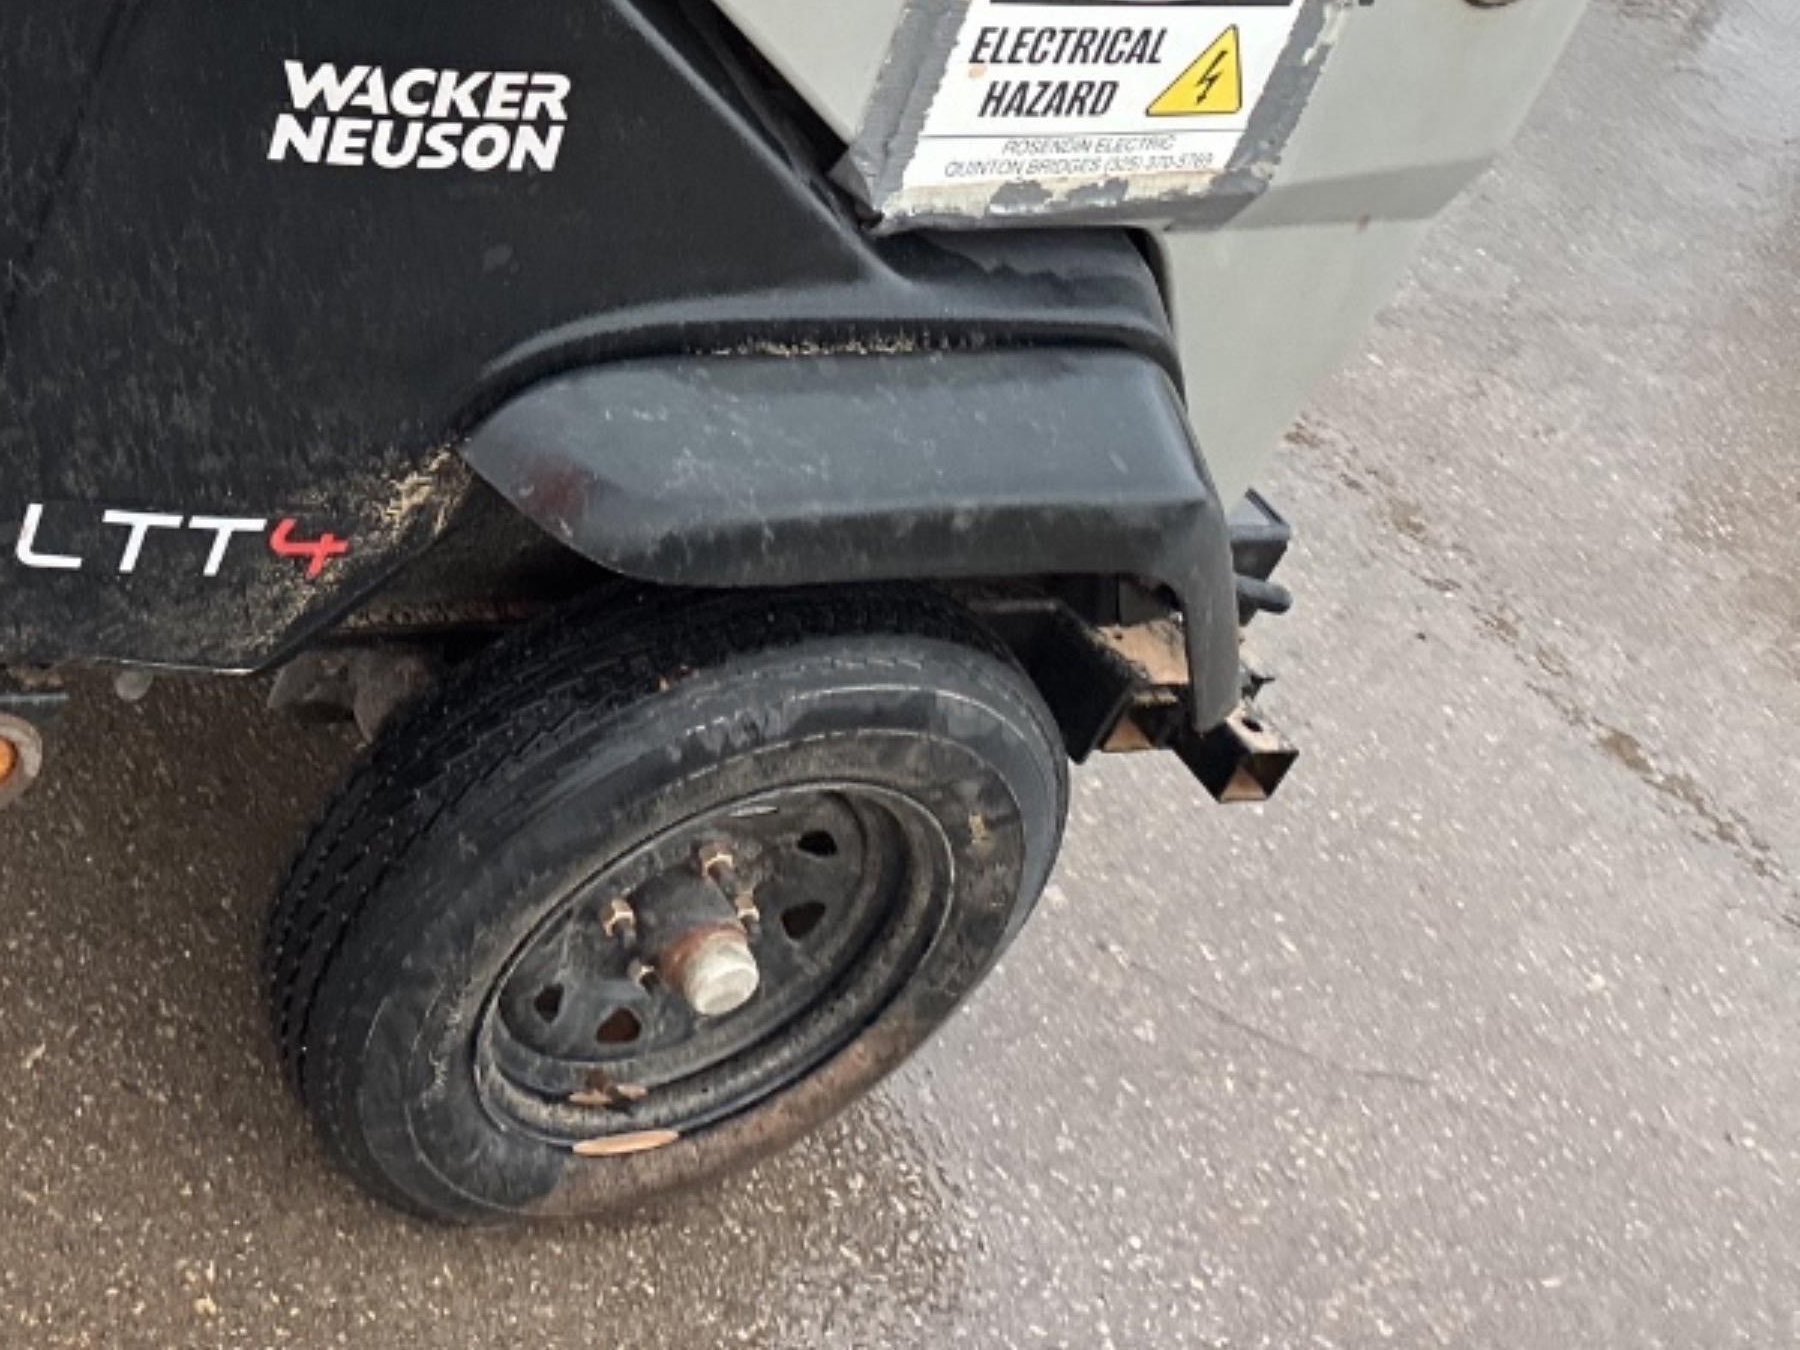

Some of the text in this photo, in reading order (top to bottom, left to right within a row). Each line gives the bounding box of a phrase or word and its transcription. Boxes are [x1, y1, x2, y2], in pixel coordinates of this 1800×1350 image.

[968, 26, 1170, 66] ELECTRICAL
[281, 60, 571, 121] WACKER
[978, 79, 1119, 118] HAZARD
[267, 114, 565, 173] NEUSON
[1094, 134, 1176, 153] ELECTRIC
[944, 159, 1022, 178] QUINTON
[1025, 156, 1102, 176] BRIDGES
[13, 502, 349, 579] LTT4
